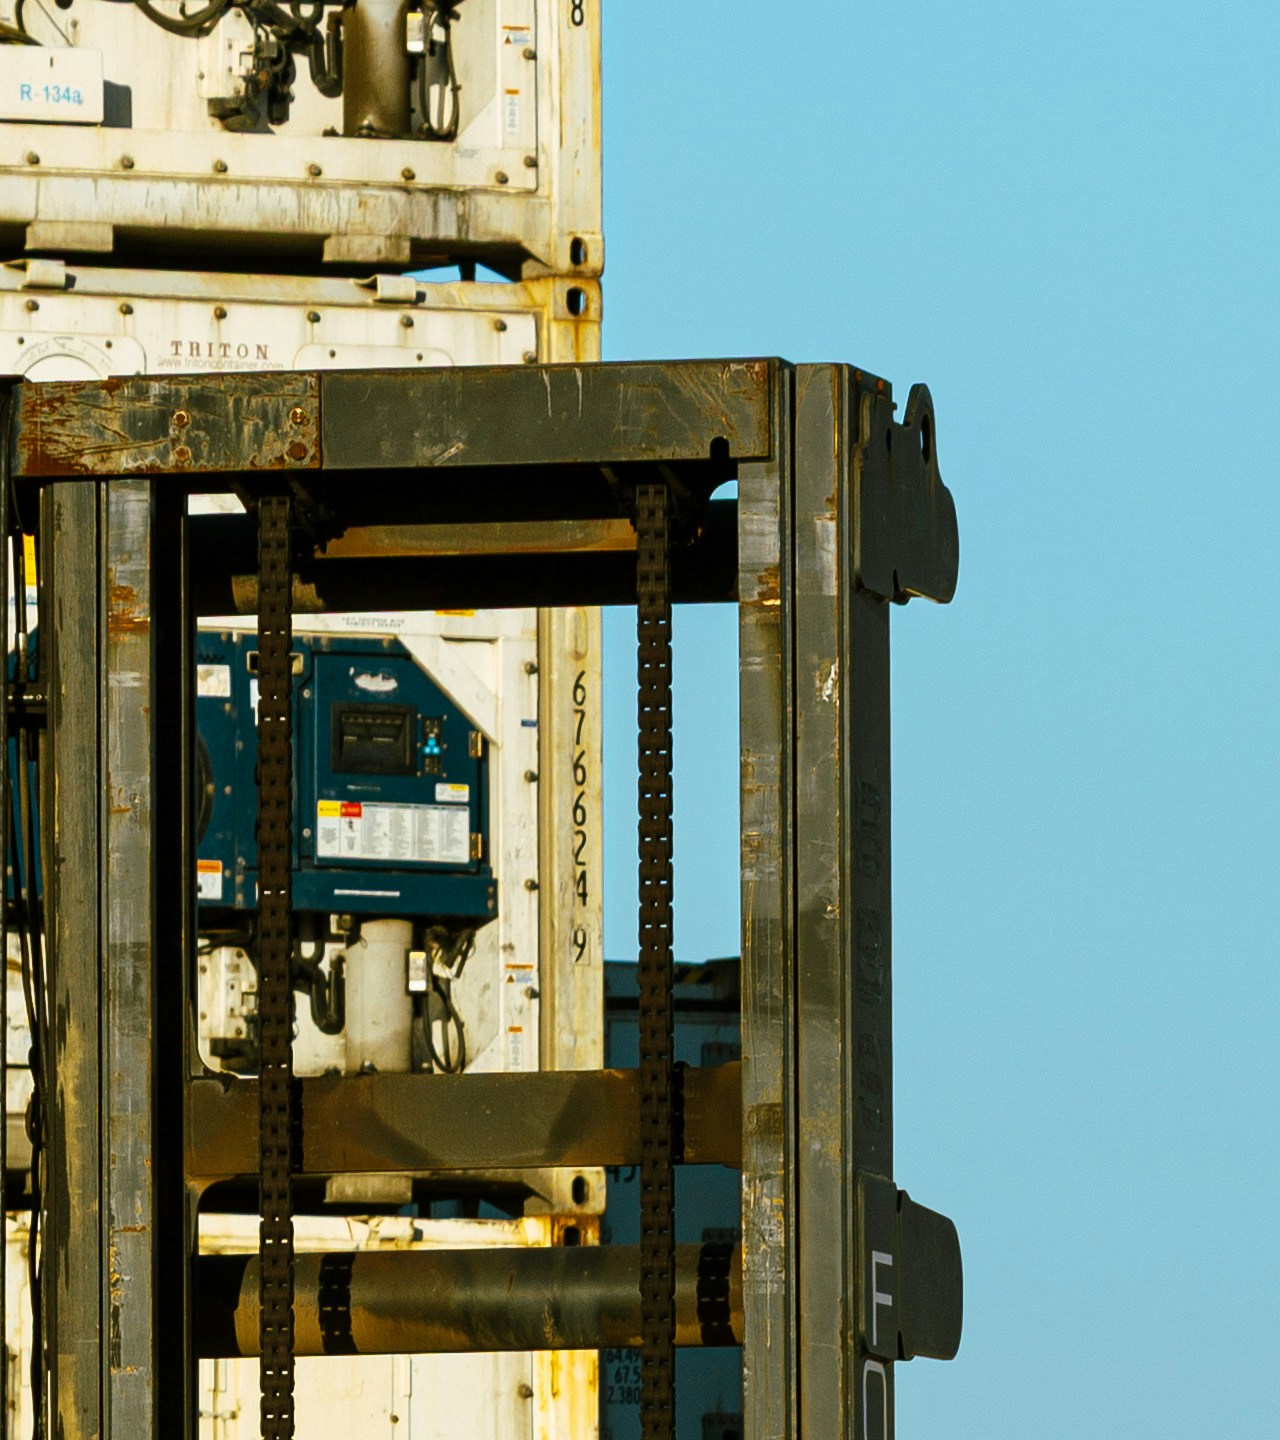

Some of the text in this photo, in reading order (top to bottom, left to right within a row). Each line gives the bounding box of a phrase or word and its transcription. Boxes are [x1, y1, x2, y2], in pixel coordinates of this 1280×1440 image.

[20, 84, 83, 105] R-134a
[171, 340, 269, 361] TRITON
[571, 671, 587, 906] 676624
[572, 930, 586, 962] 9
